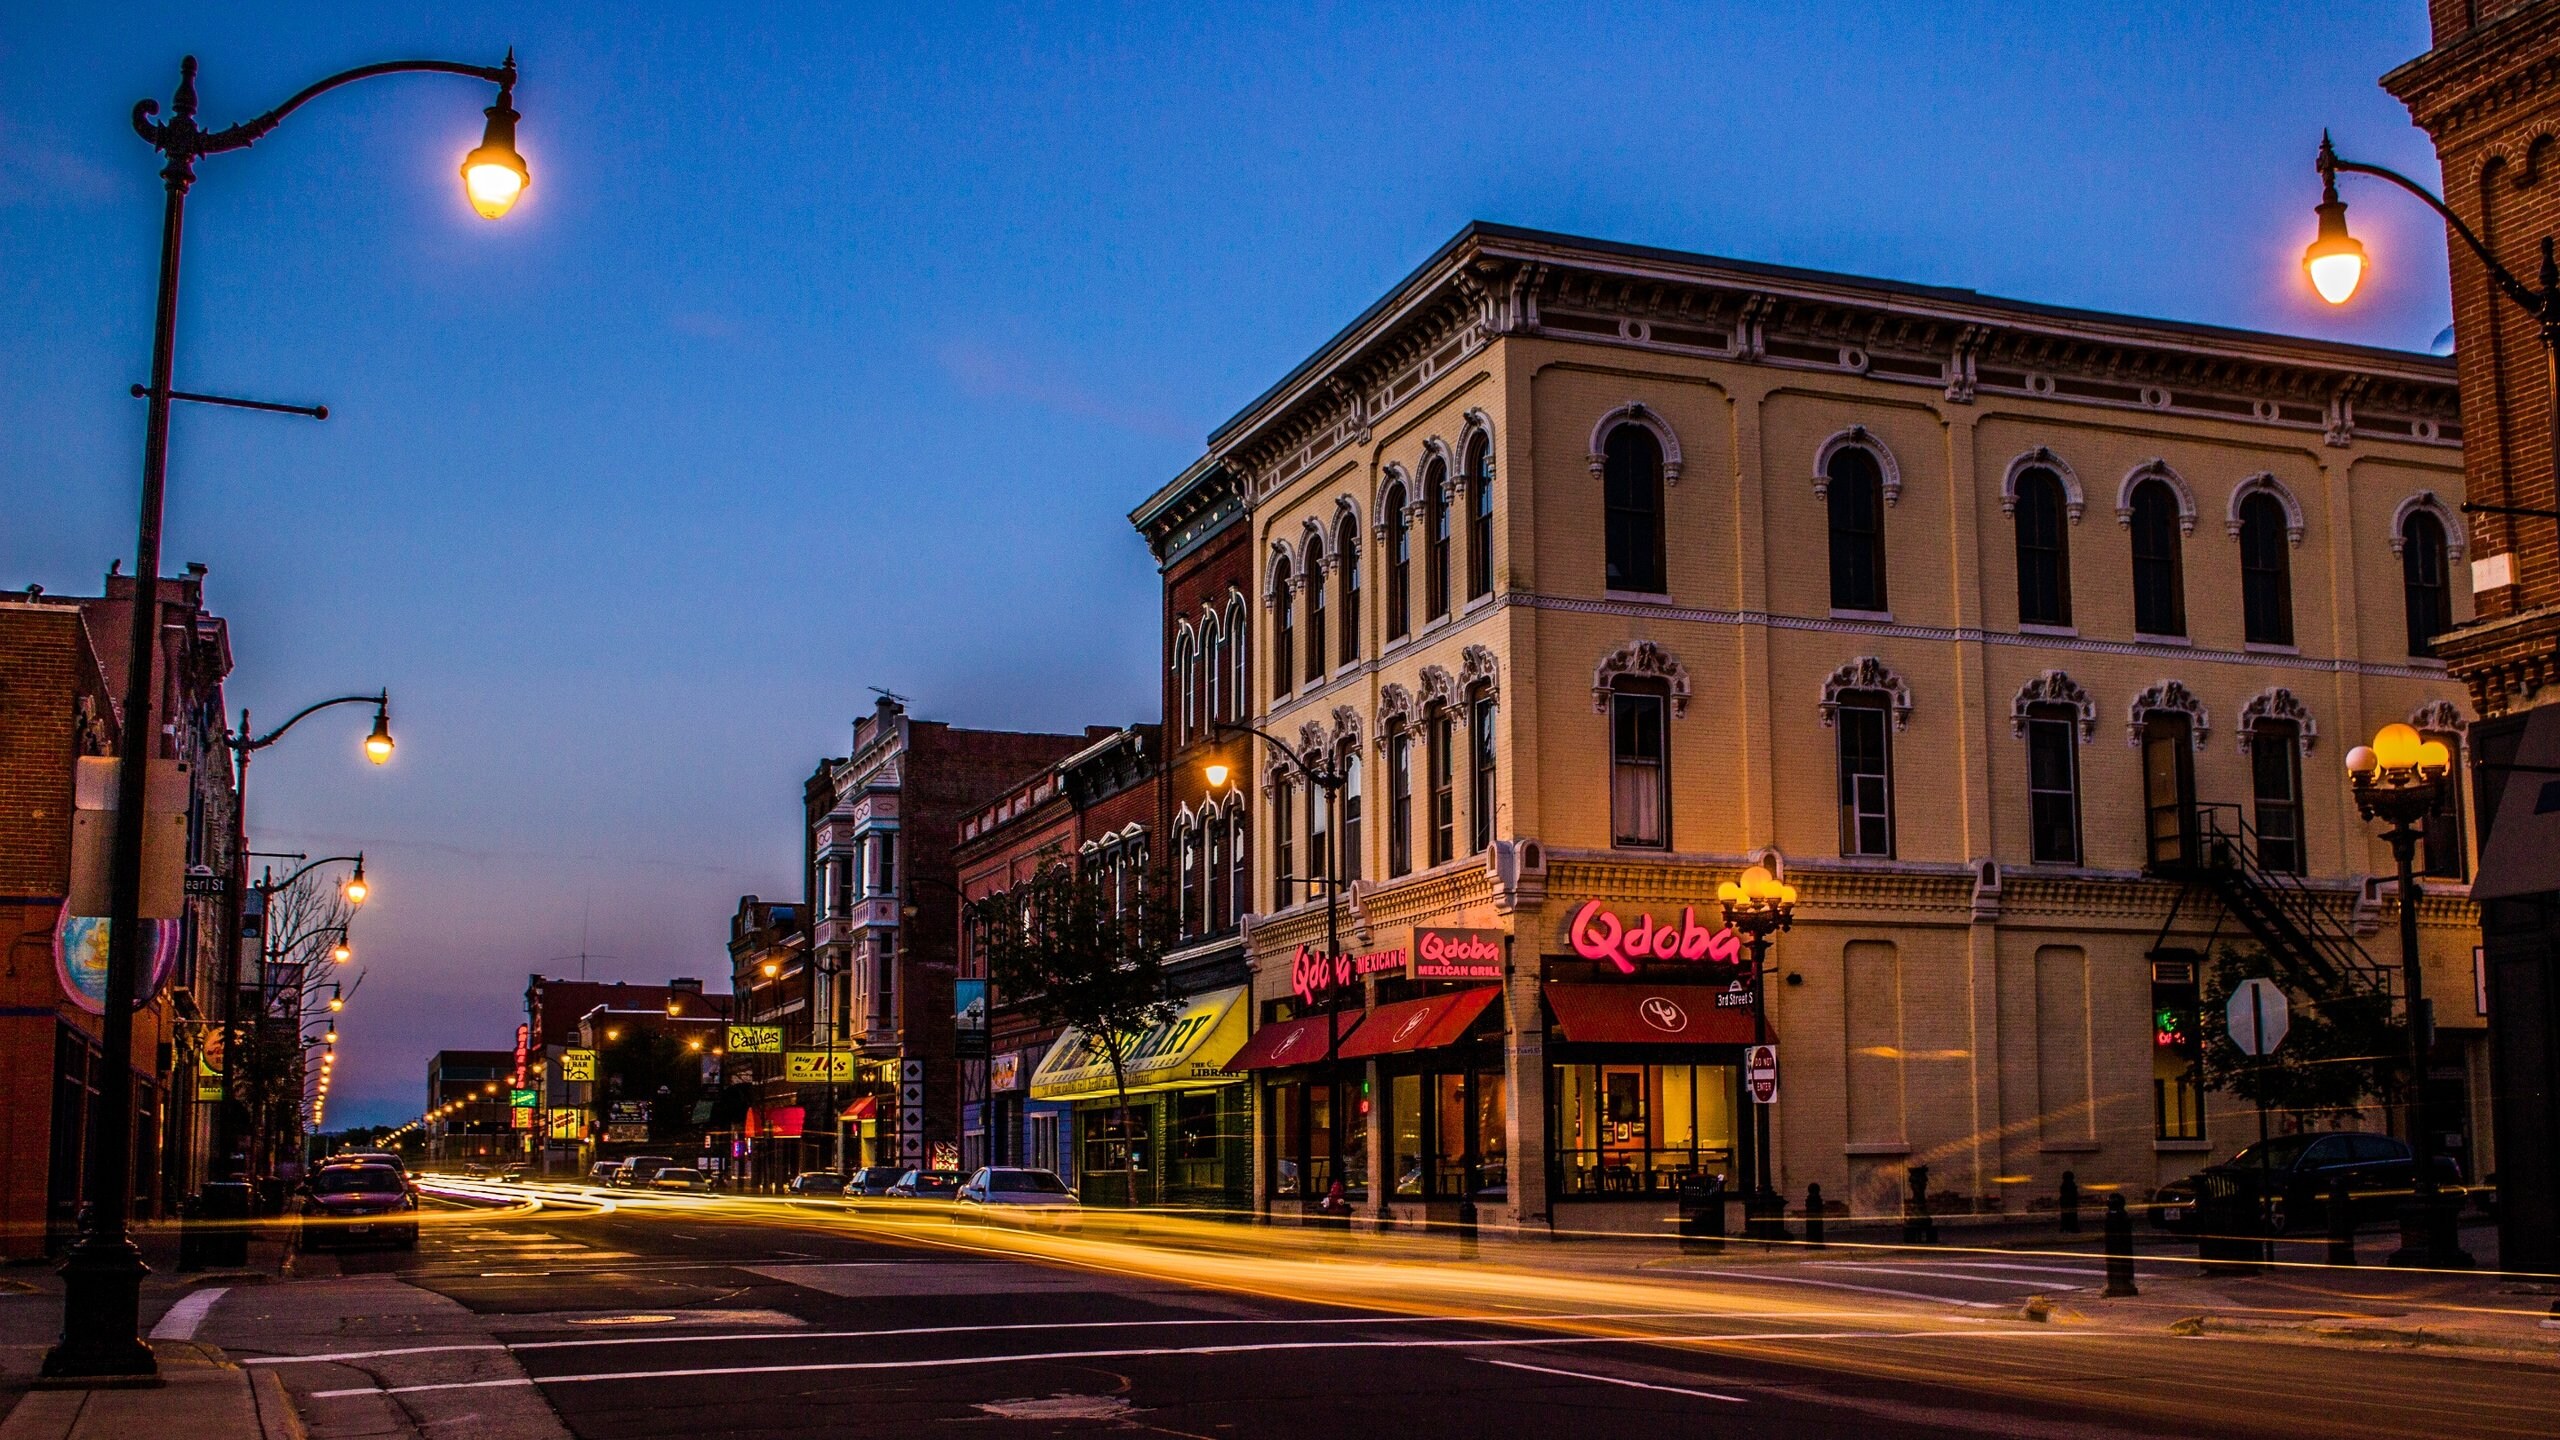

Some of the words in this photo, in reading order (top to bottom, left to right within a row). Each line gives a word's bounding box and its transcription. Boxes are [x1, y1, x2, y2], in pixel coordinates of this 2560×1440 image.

[186, 879, 209, 890] earl
[212, 878, 224, 891] St
[1572, 900, 1741, 974] Qdoba
[1420, 932, 1499, 966] Qdoba
[1357, 949, 1398, 975] MEXICAN
[1418, 965, 1468, 976] MEXICAN
[1470, 965, 1502, 976] GRILL
[1717, 994, 1729, 1006] 3rd
[1730, 992, 1748, 1005] Street
[795, 1056, 811, 1064] Big
[1755, 1057, 1762, 1066] DO
[1763, 1057, 1773, 1066] NOT
[1757, 1082, 1772, 1091] ENTER
